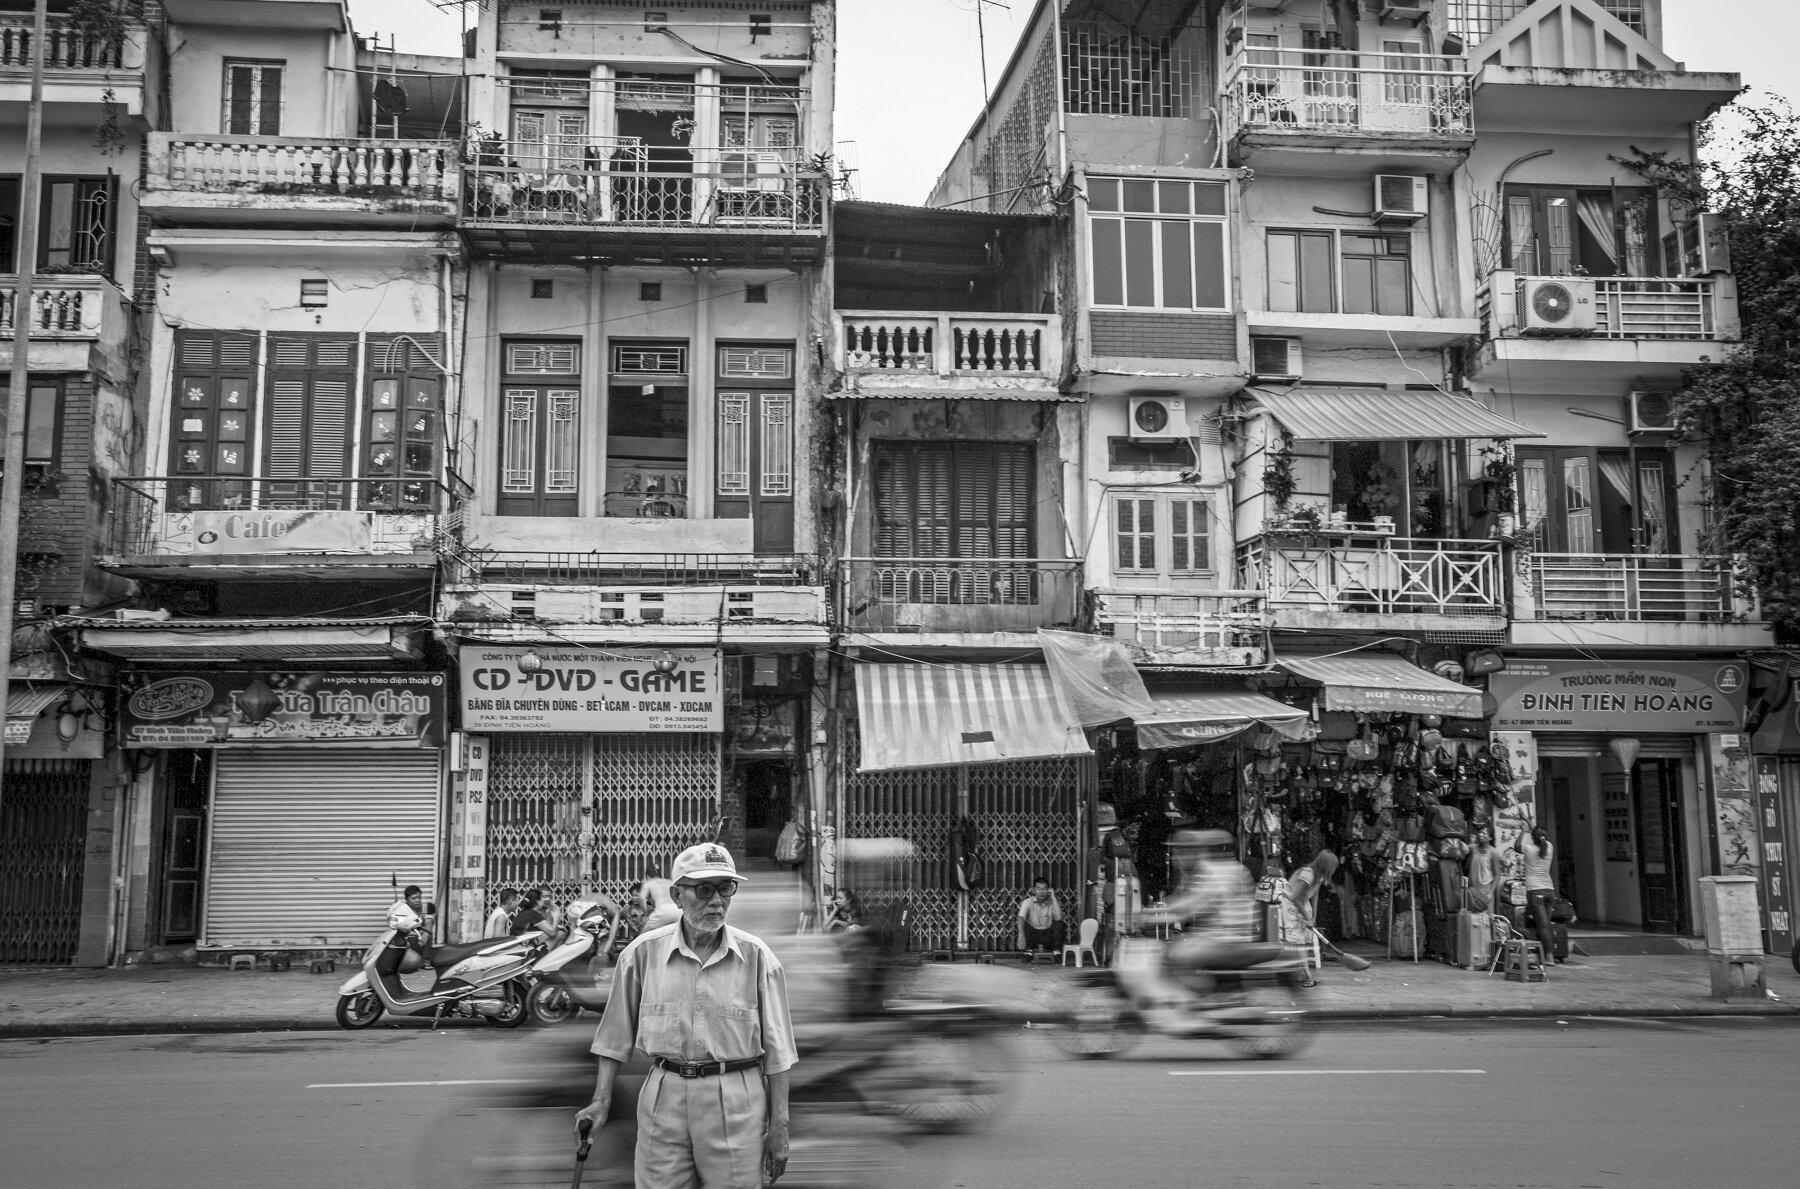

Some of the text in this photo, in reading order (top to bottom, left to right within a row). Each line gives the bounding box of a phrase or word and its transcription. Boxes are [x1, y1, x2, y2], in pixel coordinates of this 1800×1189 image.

[225, 514, 288, 539] Cafe
[482, 652, 503, 661] CÔNG
[358, 677, 369, 687] vụ
[370, 676, 388, 685] theo
[473, 668, 511, 691] CD
[535, 668, 597, 692] DVD
[620, 669, 707, 694] GAME
[1649, 675, 1677, 688] NON
[317, 689, 369, 715] Trân
[372, 688, 431, 715] Châu
[468, 697, 494, 711] BĂNG
[495, 697, 511, 711] ĐĨA
[513, 697, 550, 711] CHUYÊN
[552, 698, 578, 711] DÙNG
[586, 700, 630, 711] BETACAM
[639, 701, 671, 712] DVCAM
[680, 702, 713, 712] XDCAM
[1520, 688, 1714, 713] ĐINH TIÊN HOÀNG
[473, 746, 482, 760] CD
[470, 768, 484, 782] DVD
[469, 790, 483, 804] PS2
